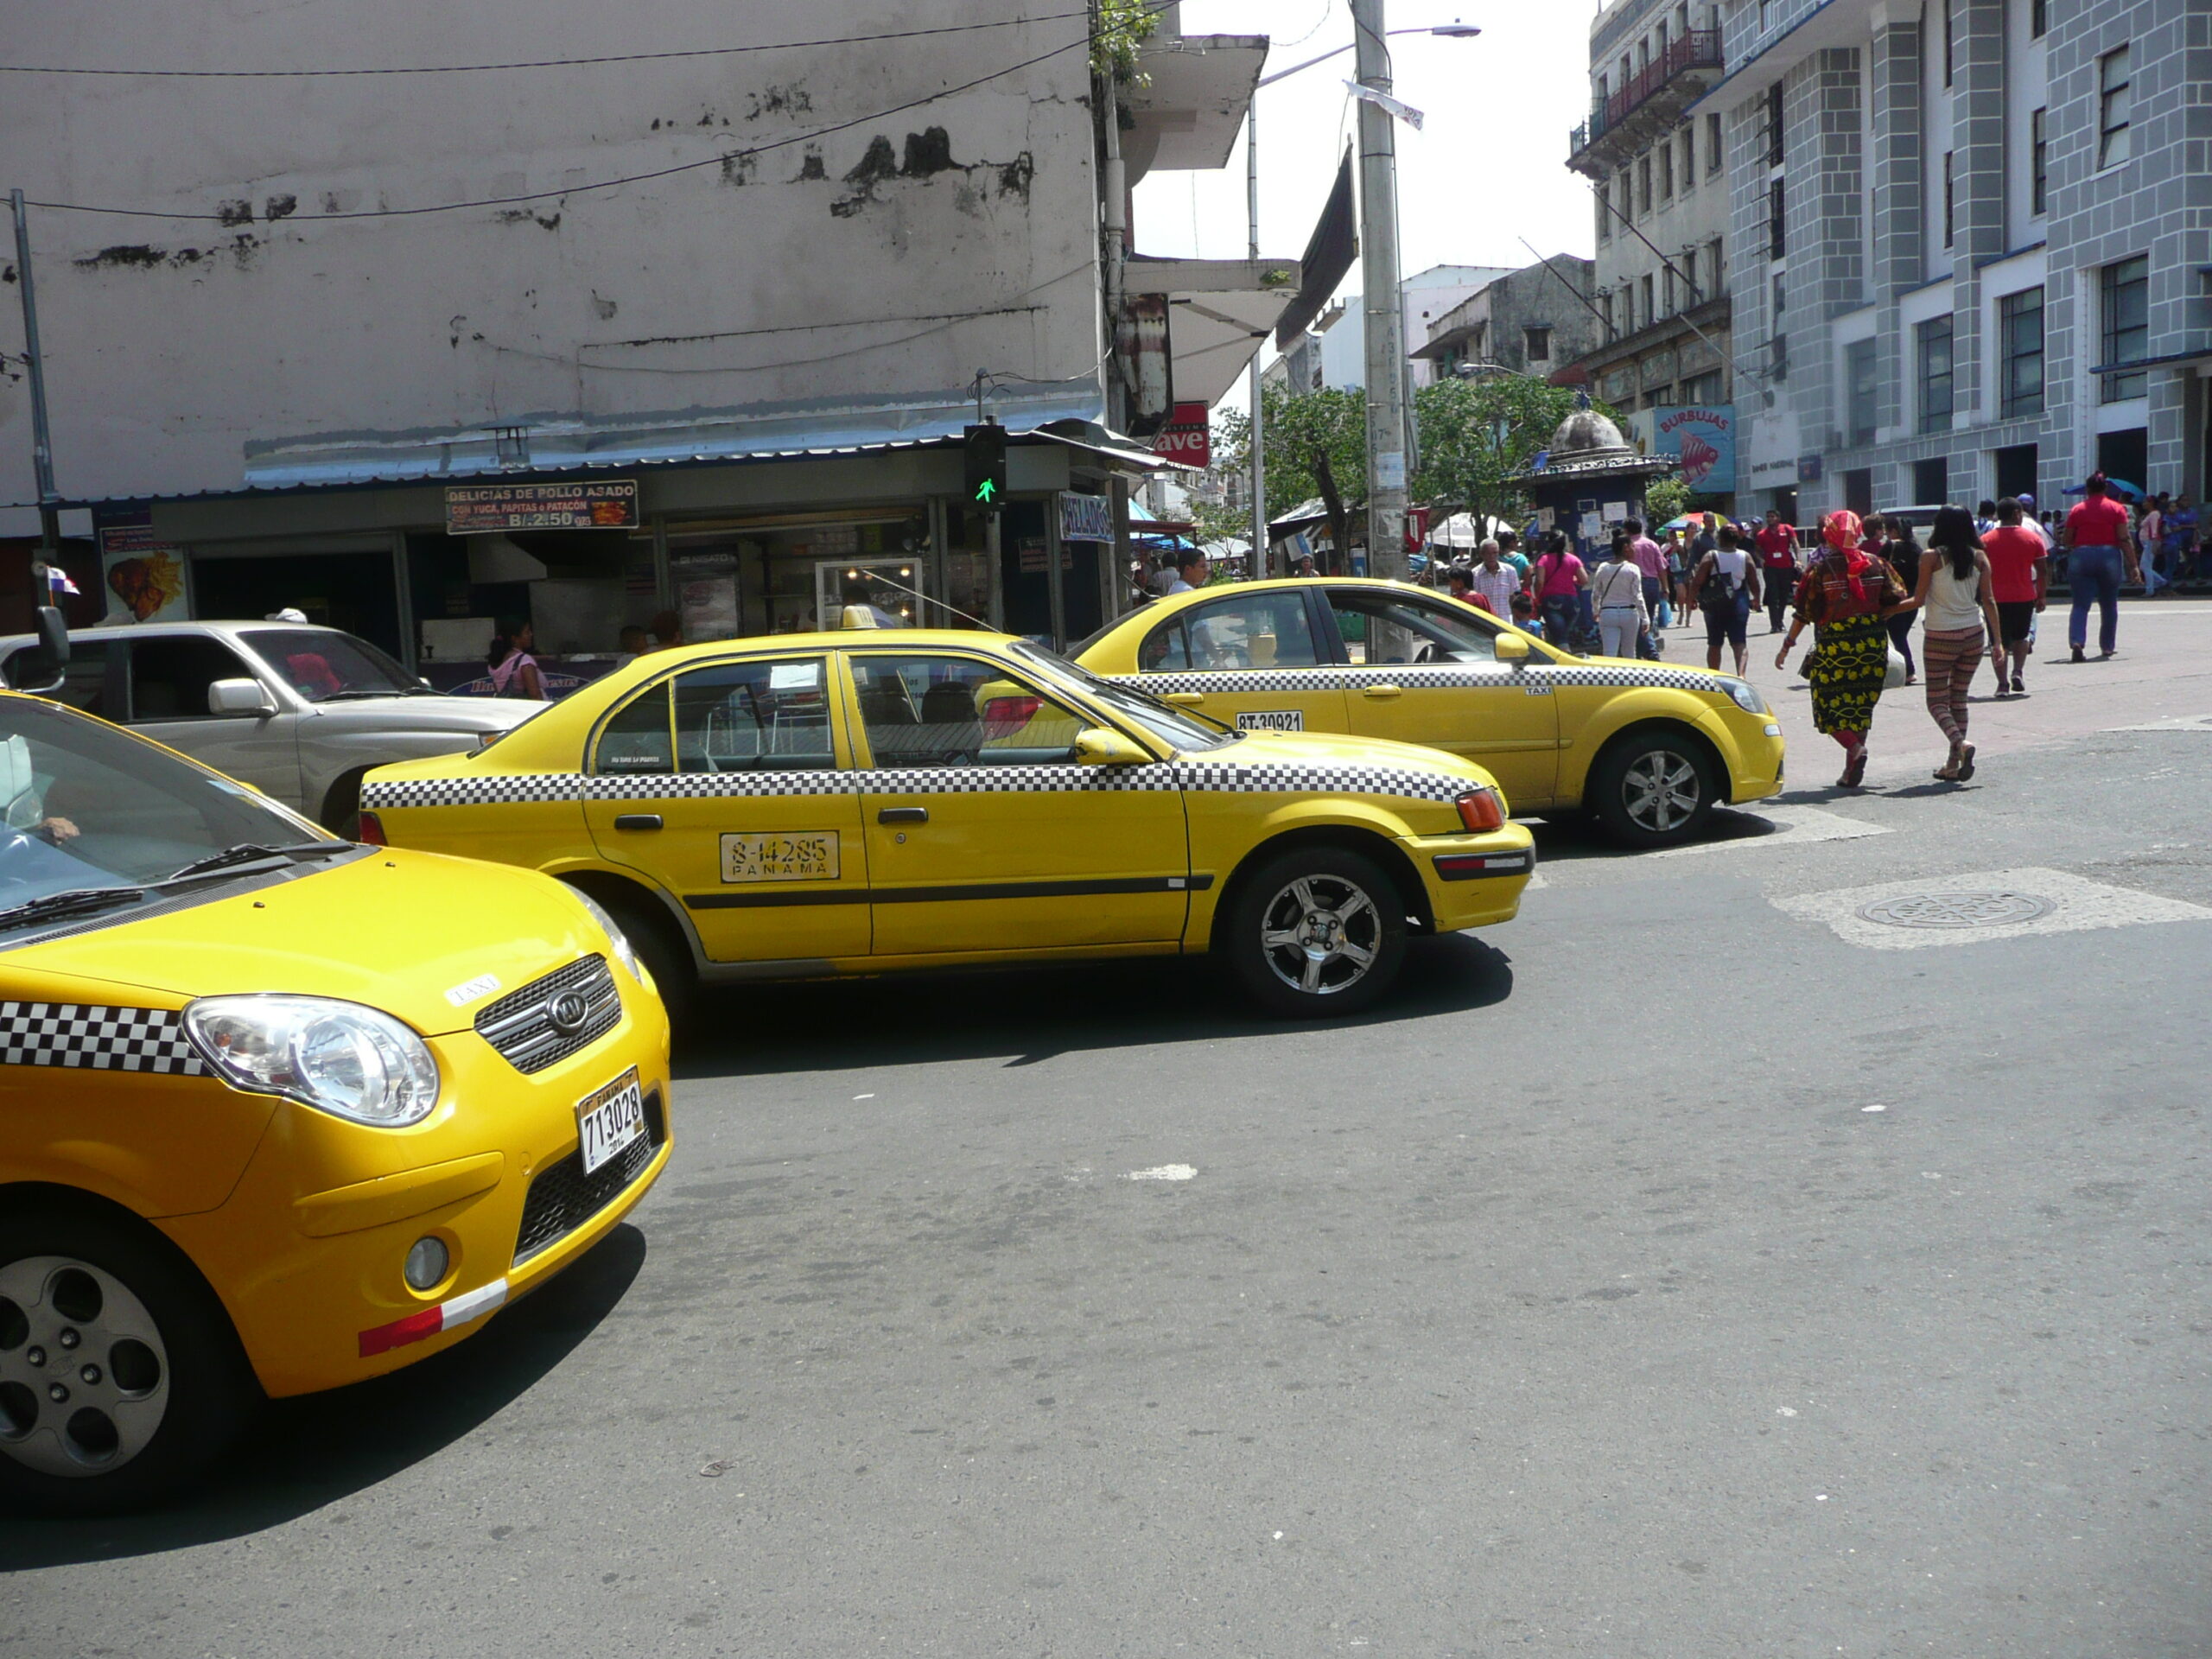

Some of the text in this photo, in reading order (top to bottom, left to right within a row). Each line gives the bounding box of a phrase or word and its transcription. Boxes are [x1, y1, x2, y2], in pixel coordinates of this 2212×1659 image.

[1659, 410, 1729, 434] BURBUJAS
[1156, 432, 1204, 452] ave
[448, 486, 634, 502] DELICIAS DE POLLO ASADO
[452, 505, 471, 515] CON
[474, 504, 500, 515] YUCA,
[501, 502, 537, 512] PAPITAS
[546, 499, 588, 511] PATACÓN
[509, 512, 572, 527] B/.2.50
[1526, 686, 1552, 695] TAXI
[1238, 713, 1300, 731] 8T-30921
[733, 838, 827, 864] 8-14285
[733, 863, 827, 875] PANAMA
[449, 977, 496, 1001] TAXI
[596, 1082, 624, 1107] PANAMA
[586, 1086, 639, 1156] 713028
